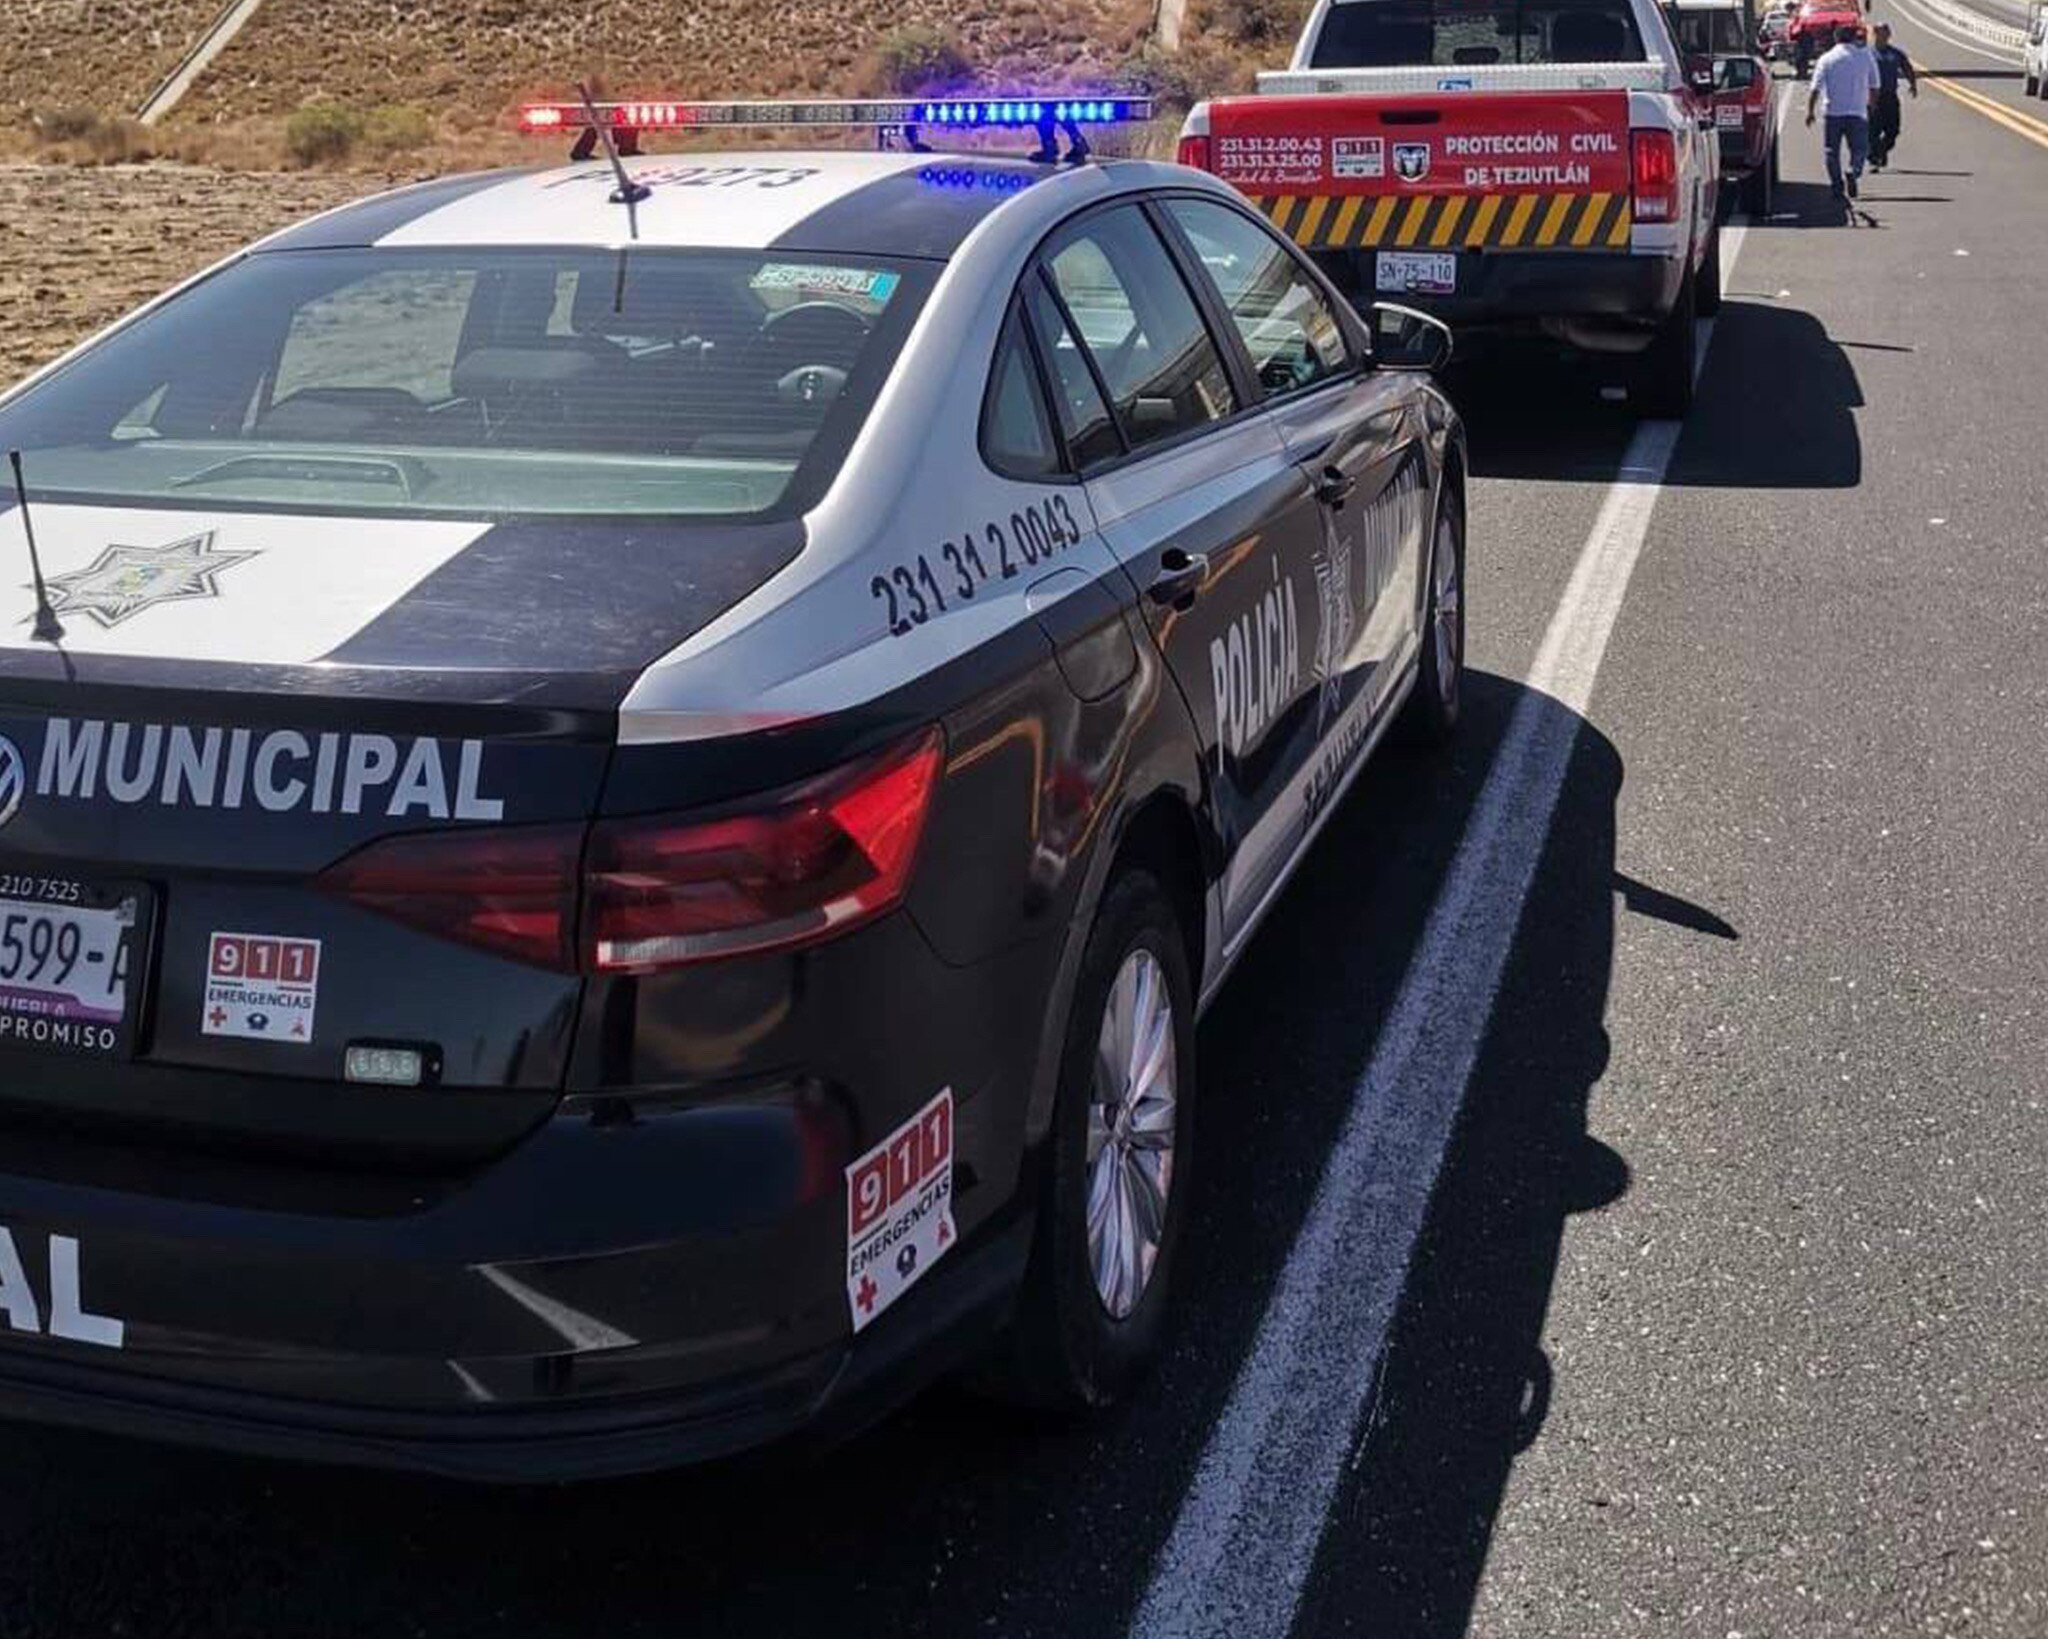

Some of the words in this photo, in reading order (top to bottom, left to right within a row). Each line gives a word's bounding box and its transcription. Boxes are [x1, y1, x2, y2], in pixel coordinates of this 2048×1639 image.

[1445, 130, 1559, 154] PROTECCIÓN
[1571, 133, 1618, 153] CIVIL
[1465, 167, 1490, 185] DE
[1494, 161, 1590, 185] TEZIUTLÁN
[871, 554, 948, 637] 231
[943, 534, 987, 600] 31
[986, 522, 1019, 580] 2
[1010, 494, 1081, 566] 0043
[1210, 552, 1299, 776] POLICÍA
[36, 717, 504, 821] MUNICIPAL
[36, 878, 81, 901] 7525
[219, 944, 304, 977] 911
[208, 987, 313, 1010] EMERGENCIAS
[859, 1112, 942, 1222] 911
[850, 1175, 951, 1277] EMERGENCIAS
